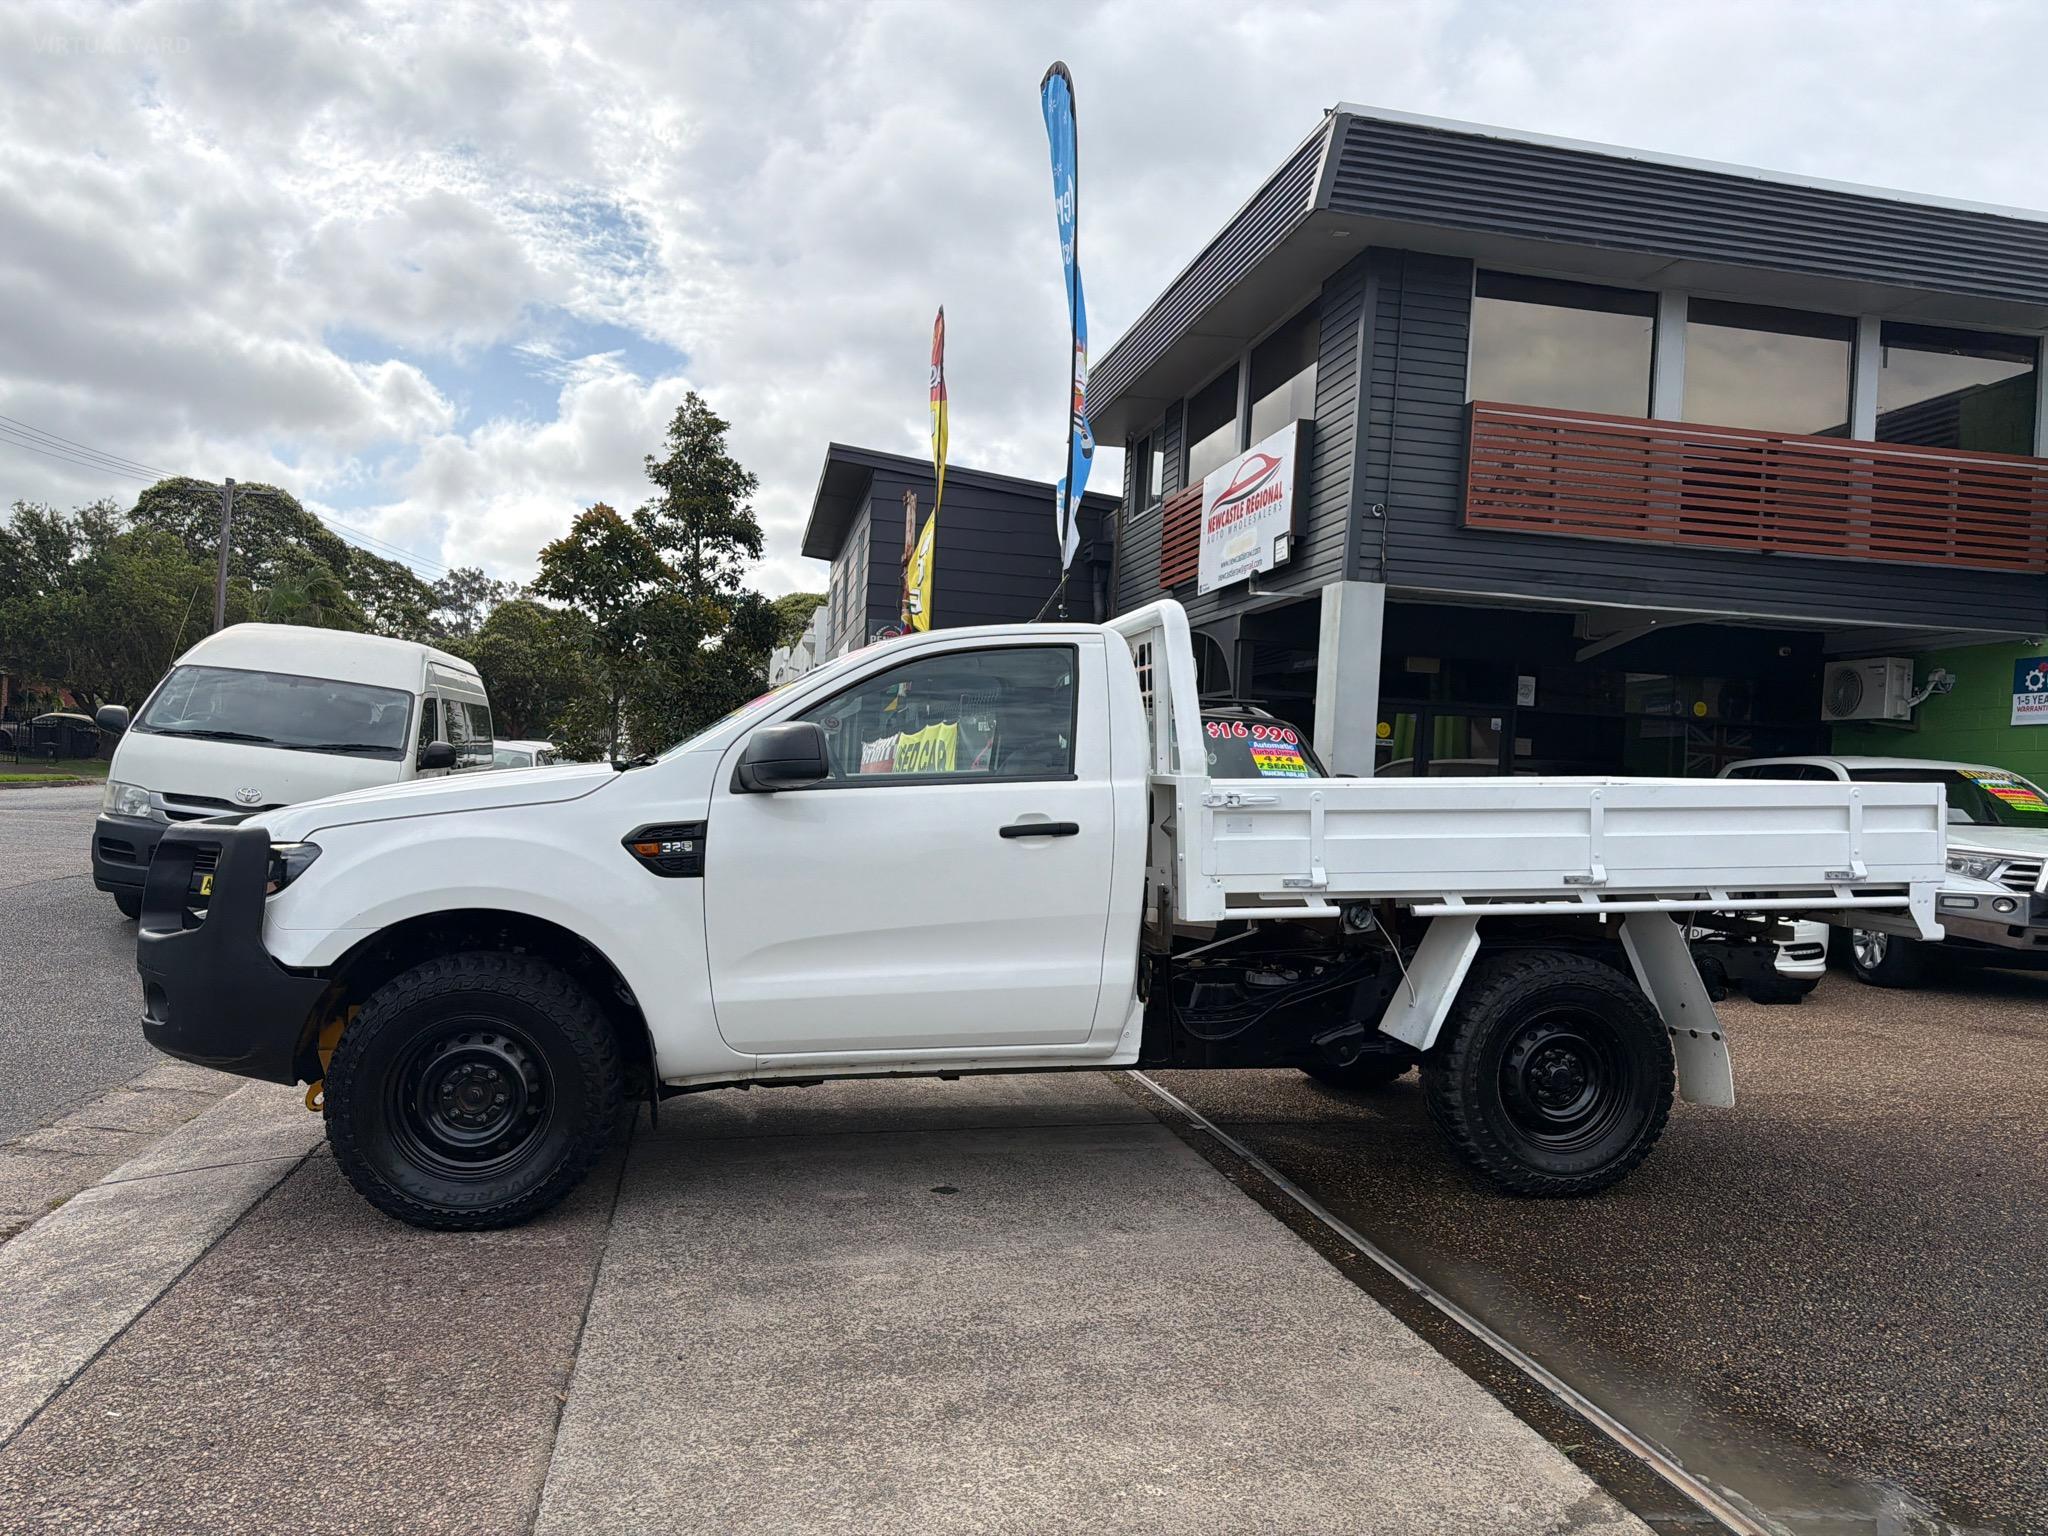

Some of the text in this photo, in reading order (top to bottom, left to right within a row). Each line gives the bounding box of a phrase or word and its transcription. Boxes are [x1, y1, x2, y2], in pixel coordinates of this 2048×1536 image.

[1207, 481, 1283, 535] NEWCASTLE REGIONAL
[1207, 501, 1282, 545] AUTO WHOLESALERS
[2016, 695, 2030, 705] 1-5
[1252, 725, 1298, 744] 990
[1253, 742, 1295, 750] Automatic
[1268, 763, 1305, 771] SEATER
